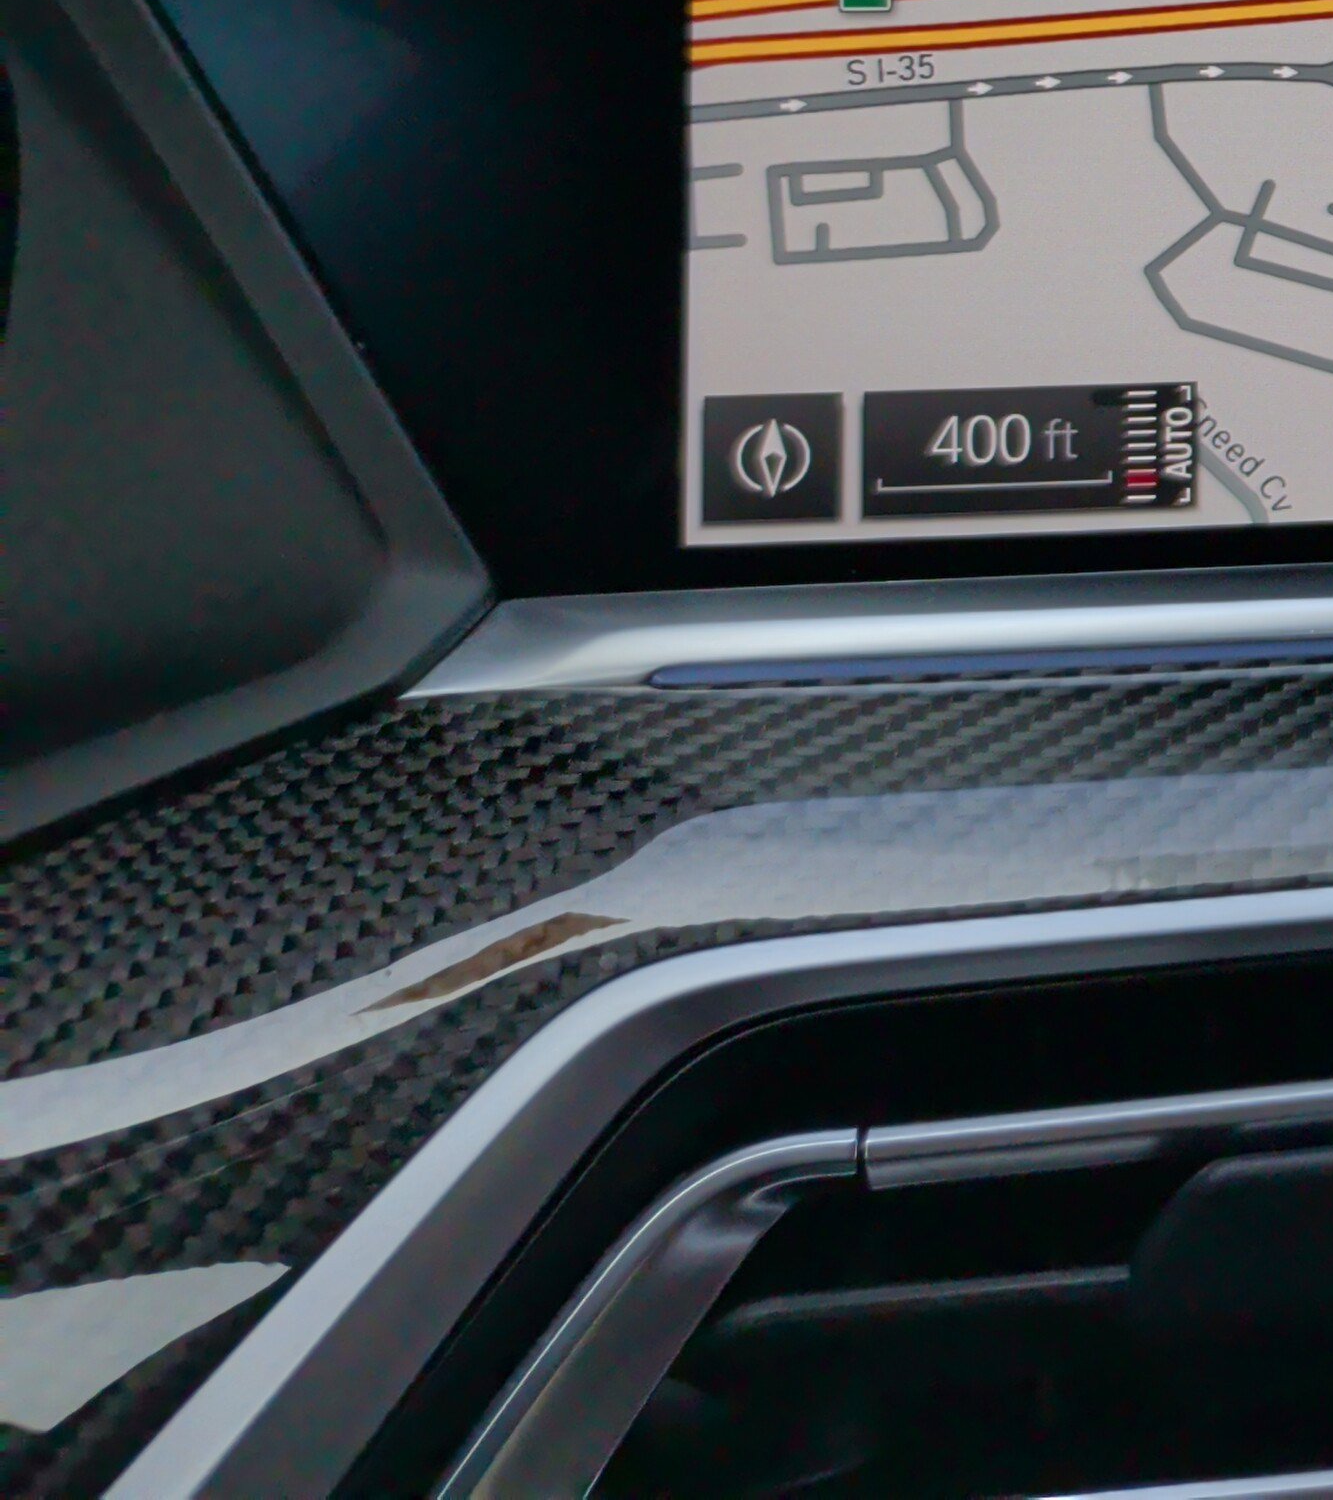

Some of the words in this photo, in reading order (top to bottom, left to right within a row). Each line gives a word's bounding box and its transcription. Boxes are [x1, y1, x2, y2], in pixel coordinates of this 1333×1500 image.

[846, 58, 868, 86] S
[877, 53, 935, 83] I-35
[928, 412, 1032, 466] 400
[1043, 418, 1080, 461] ft
[1164, 406, 1194, 480] AUTO
[1260, 475, 1293, 512] Cv
